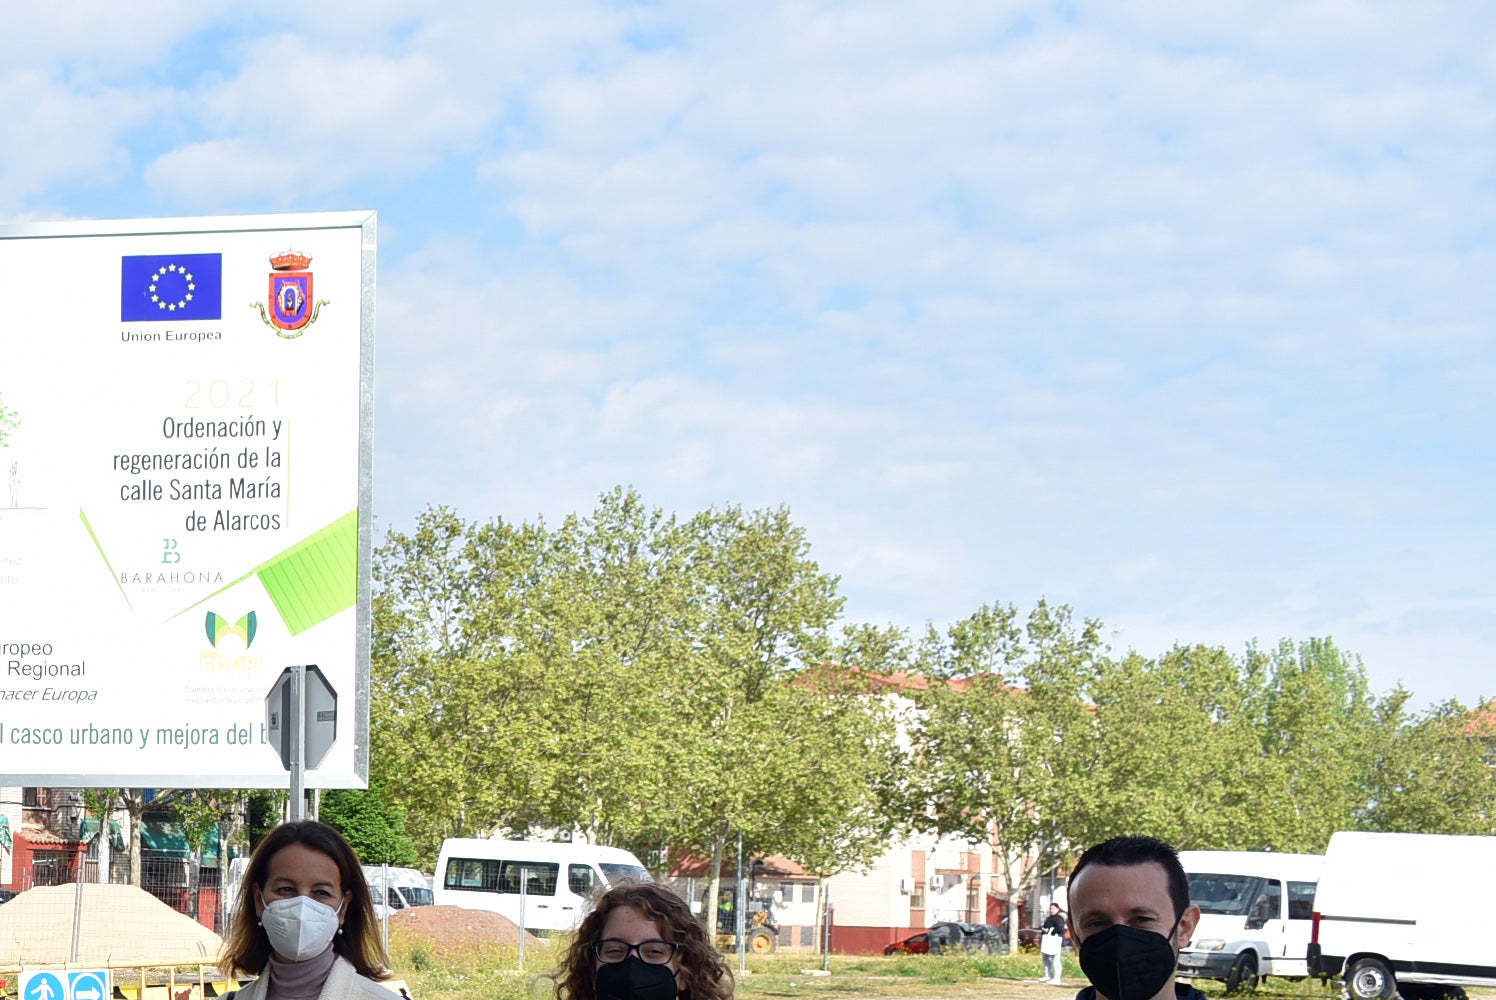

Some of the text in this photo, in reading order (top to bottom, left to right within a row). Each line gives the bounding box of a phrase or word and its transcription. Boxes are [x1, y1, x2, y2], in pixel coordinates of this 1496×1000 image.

[121, 330, 222, 343] Unión Europea
[184, 378, 280, 409] 2021
[162, 414, 282, 441] Ordenación y
[113, 446, 281, 475] regeneración de la
[120, 475, 281, 501] calle Santa María
[185, 509, 281, 532] de Alarcos
[120, 571, 224, 584] BARAHONA
[7, 660, 85, 681] Regional
[41, 687, 98, 705] Europa
[10, 727, 63, 745] casco
[70, 722, 134, 745] urbano
[139, 728, 150, 750] y
[156, 722, 219, 750] mejora
[226, 722, 253, 746] del
